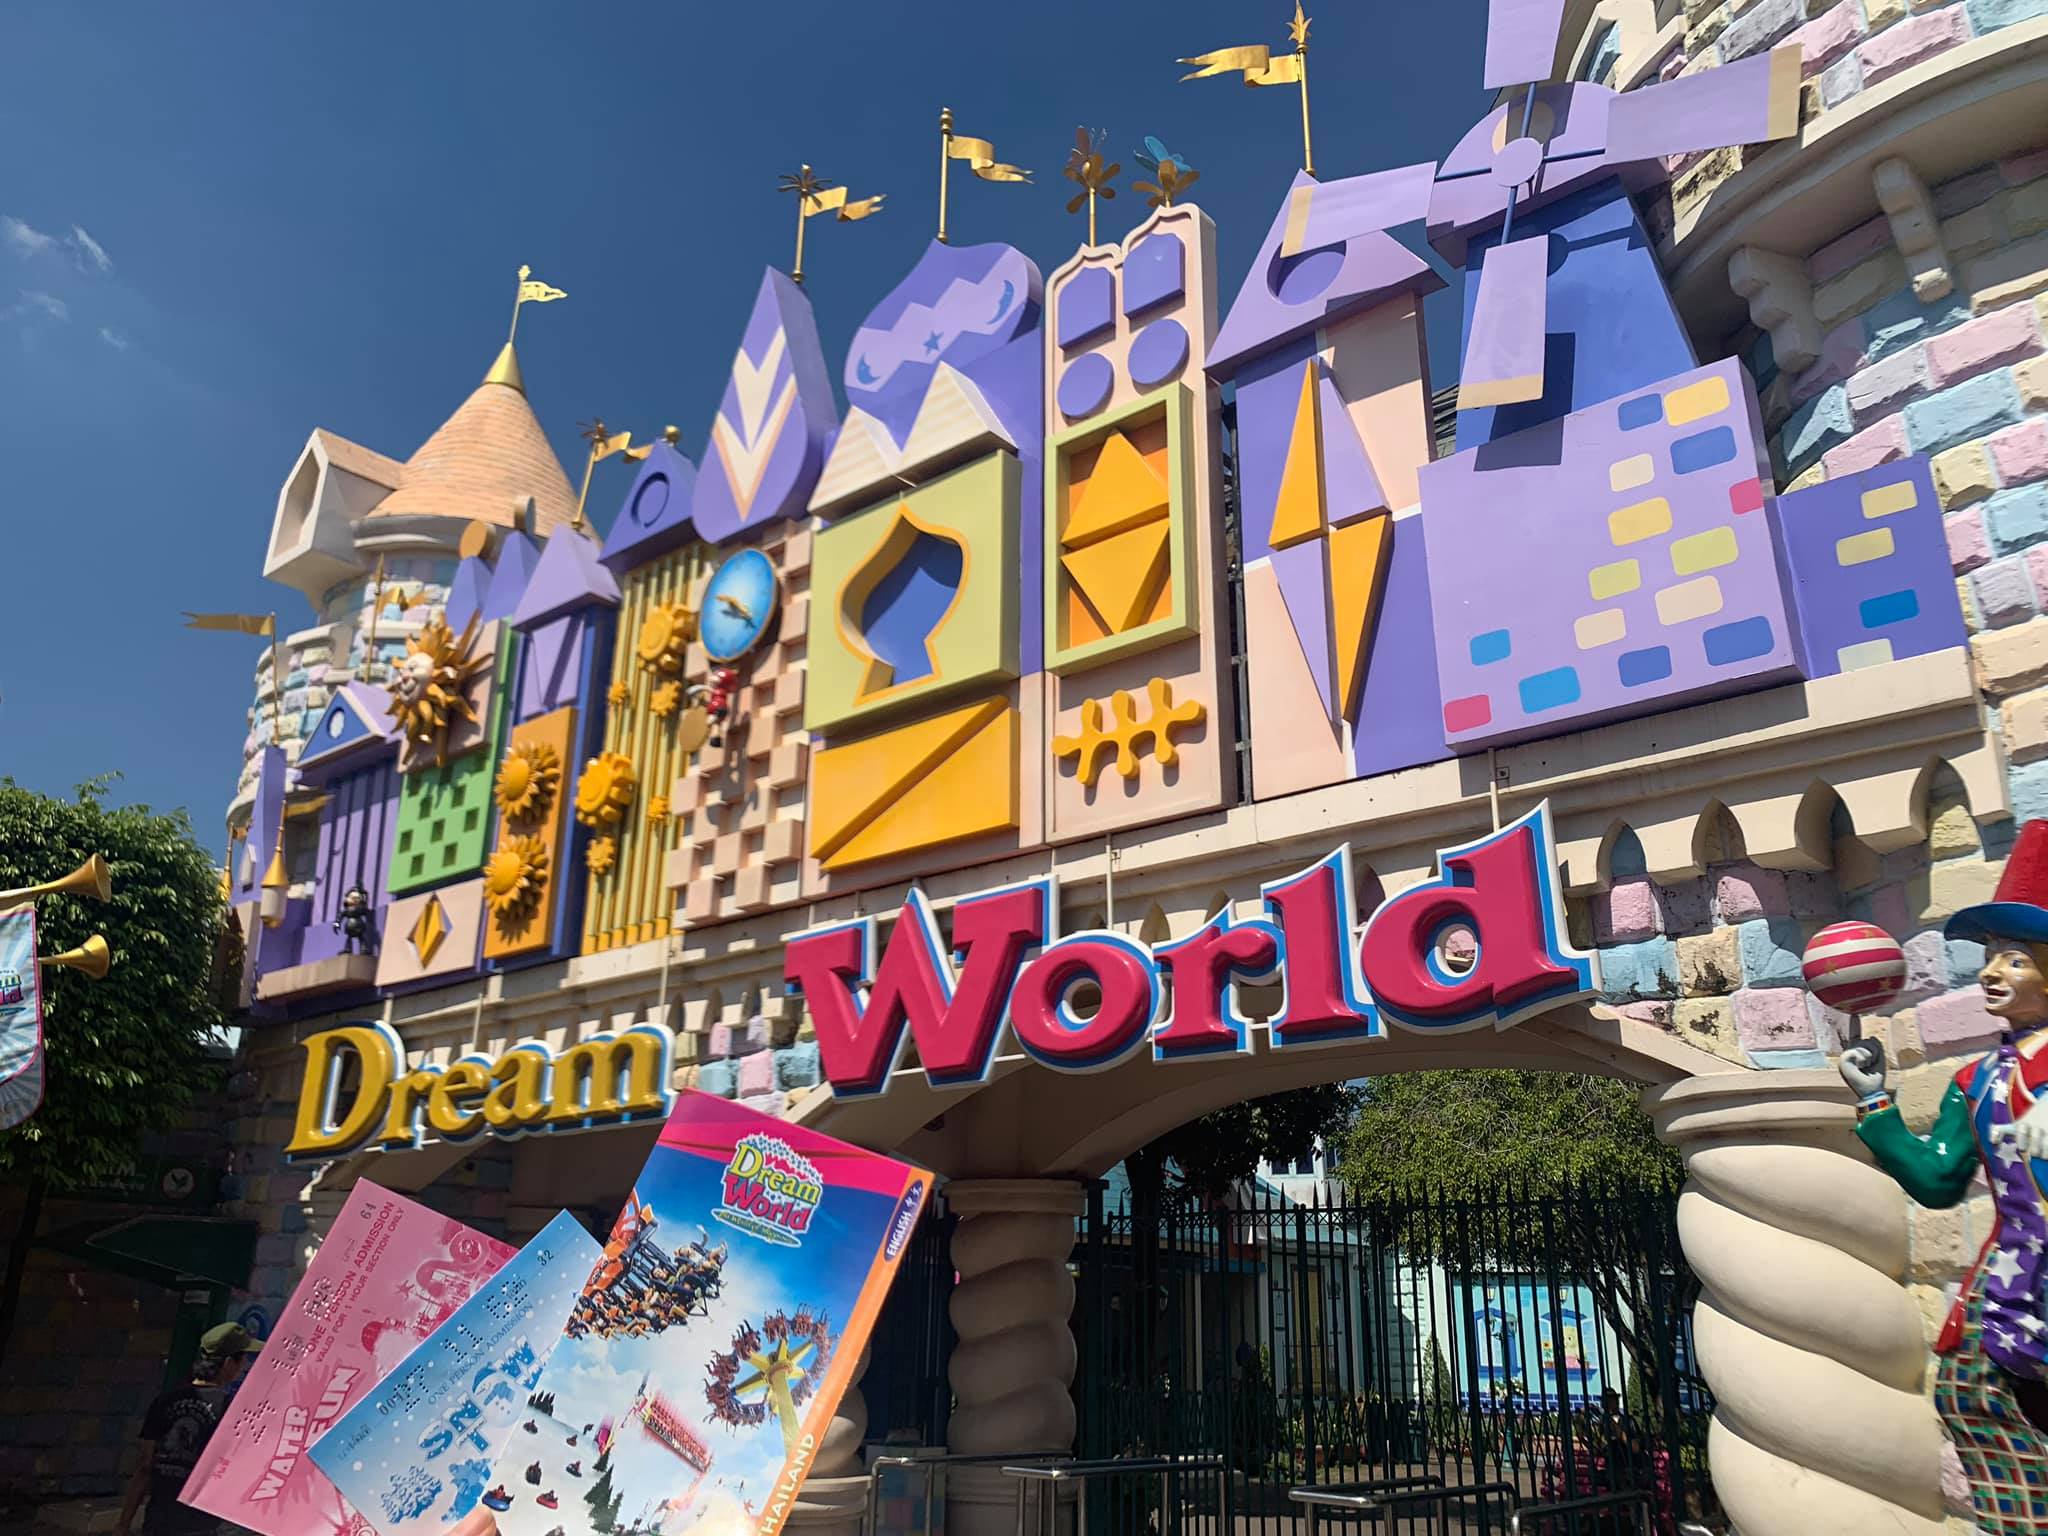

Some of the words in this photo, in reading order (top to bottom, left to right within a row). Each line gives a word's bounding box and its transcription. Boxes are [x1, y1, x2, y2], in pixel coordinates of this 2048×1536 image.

[284, 1023, 672, 1157] Dream
[784, 805, 1595, 1097] World
[360, 1201, 378, 1221] 64
[723, 1175, 812, 1231] World
[730, 1143, 821, 1205] Dream
[536, 1249, 554, 1266] 32
[886, 1210, 912, 1256] ENGLISH
[303, 1323, 327, 1354] ONE
[321, 1269, 357, 1322] PERSON
[351, 1200, 396, 1268] ADMISSION
[315, 1335, 336, 1364] VALID
[331, 1312, 348, 1333] FOR
[348, 1273, 369, 1302] HOUR
[364, 1232, 392, 1273] SECTION
[387, 1206, 406, 1232] ONLY
[391, 1364, 430, 1413] 27
[443, 1323, 483, 1363] 11
[424, 1381, 450, 1405] ONE
[447, 1346, 487, 1384] PERSON
[483, 1301, 535, 1350] ADMISSION
[306, 1366, 360, 1445] FUN
[248, 1405, 307, 1500] WATER
